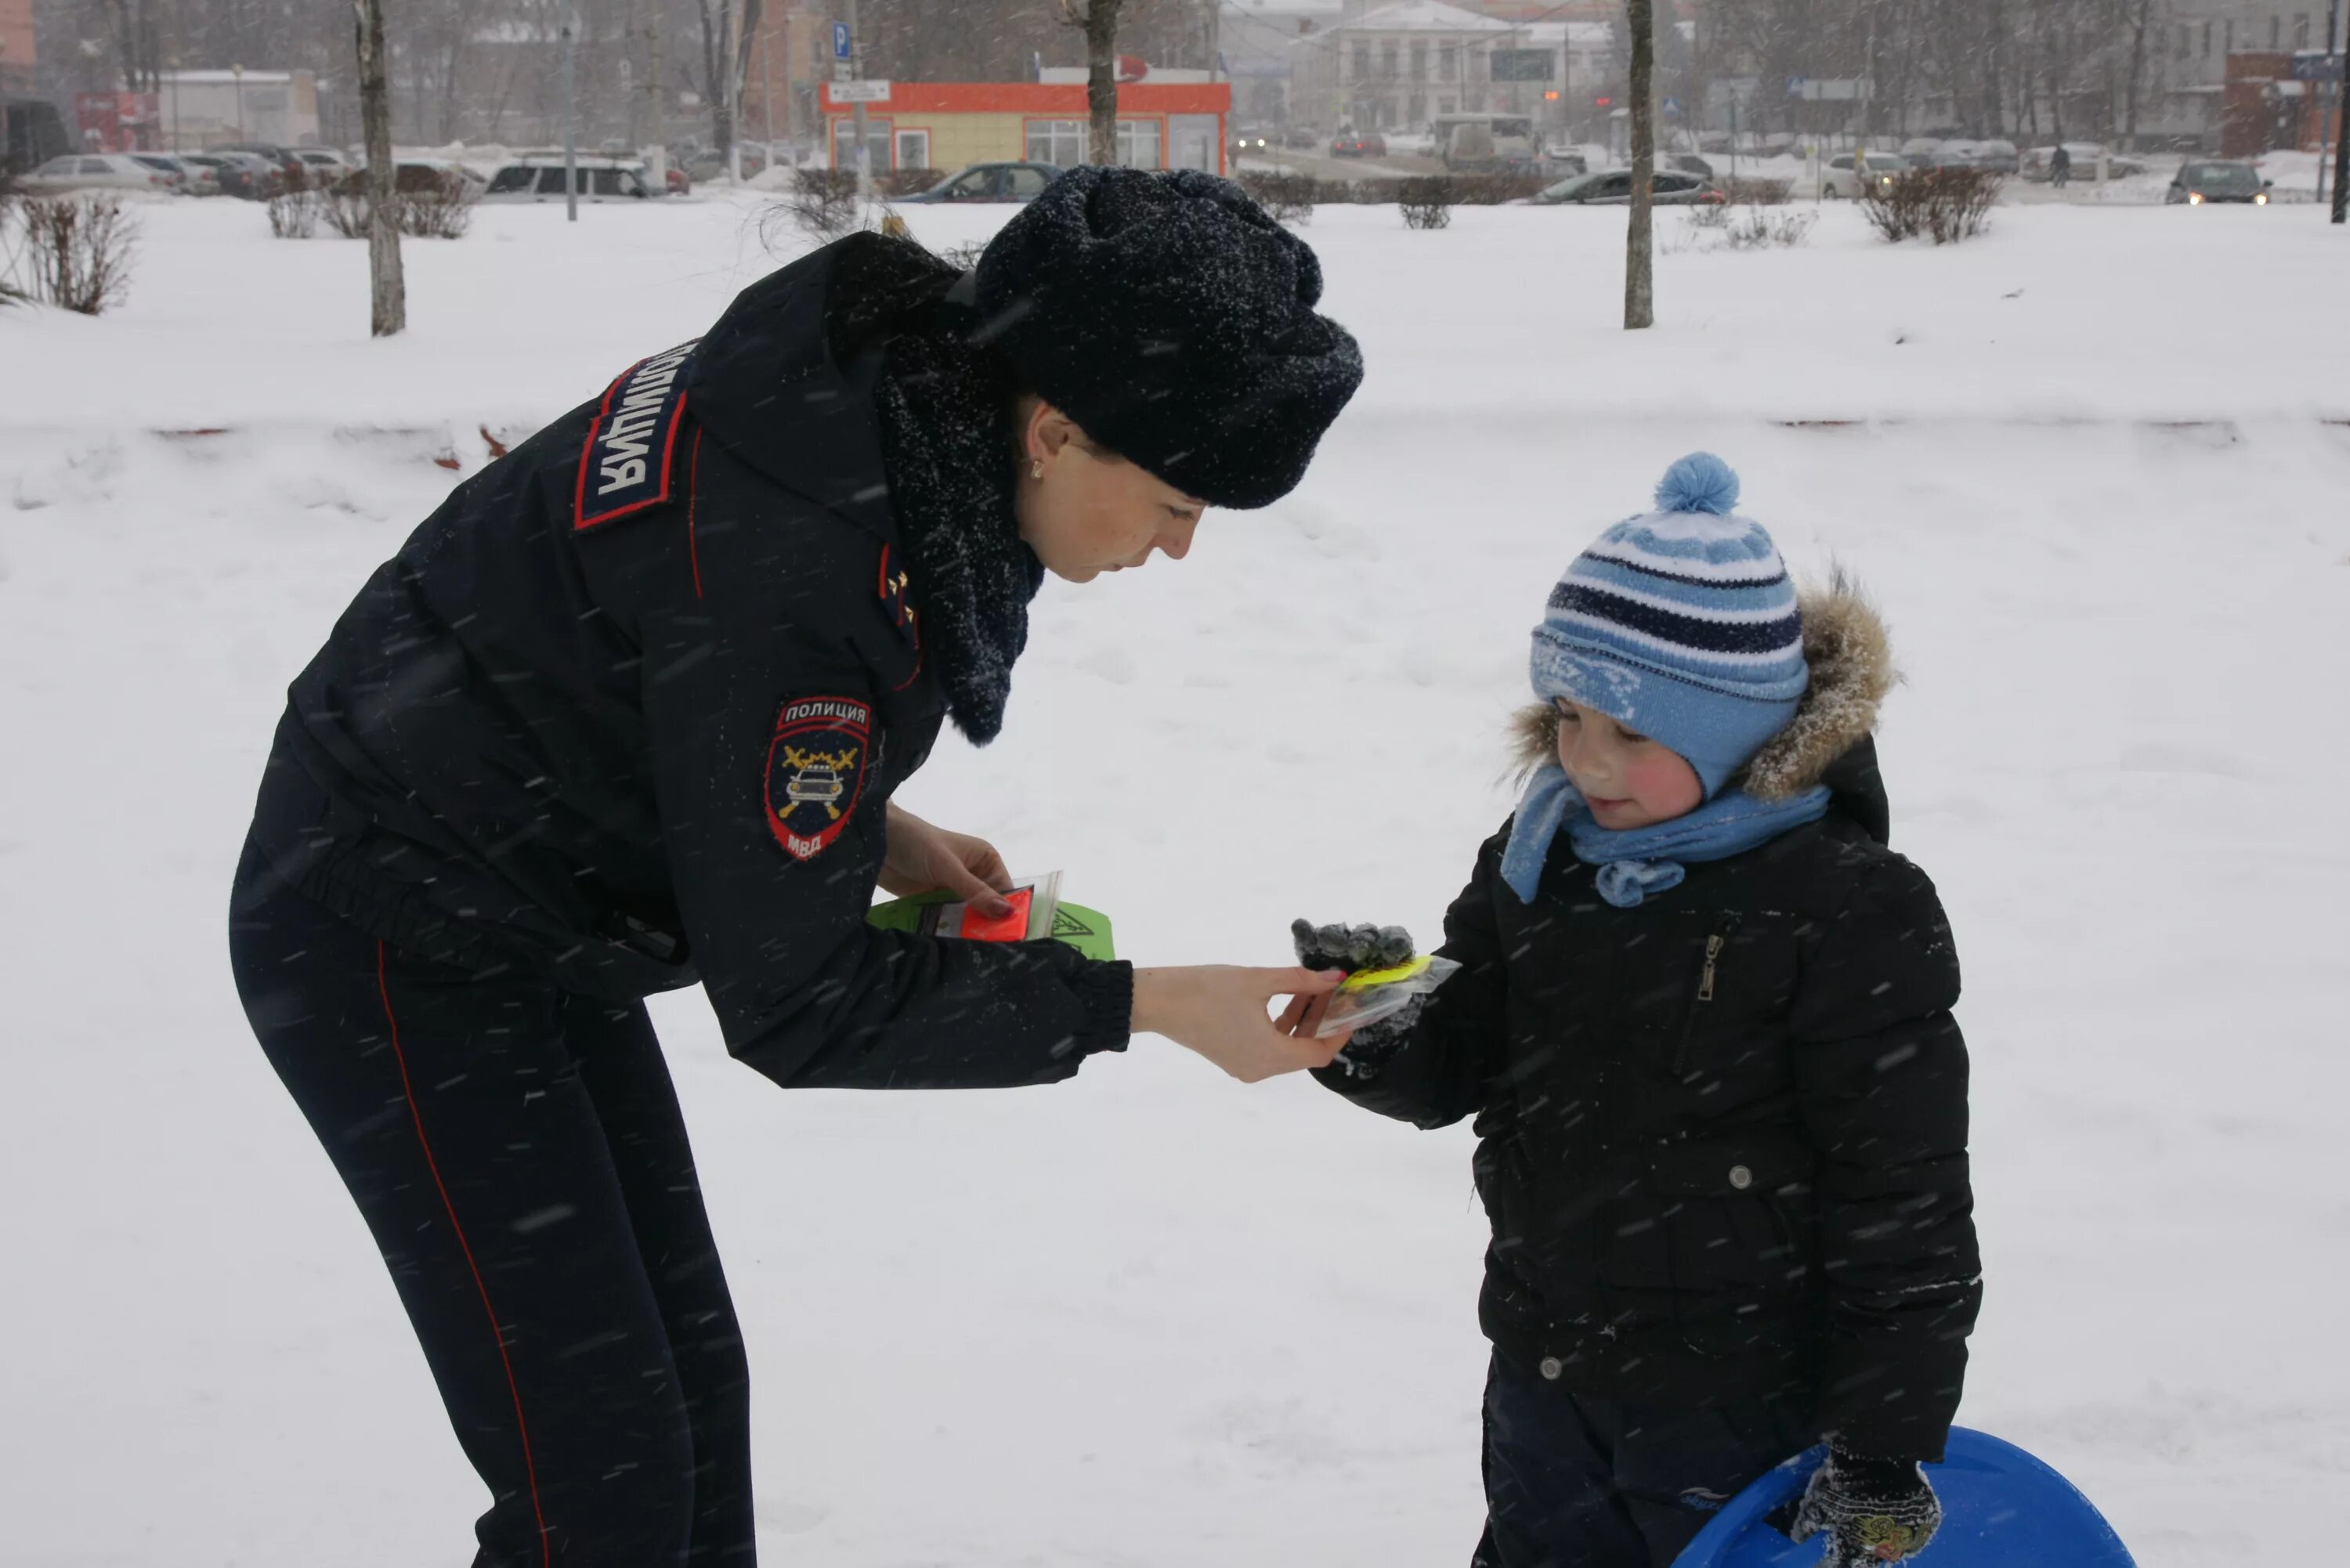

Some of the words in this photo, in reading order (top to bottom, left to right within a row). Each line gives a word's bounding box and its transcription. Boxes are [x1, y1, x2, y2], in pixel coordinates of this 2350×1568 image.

[837, 26, 846, 53] P
[786, 703, 866, 724] ПОЛИЦИЯ
[787, 834, 821, 857] МВД
